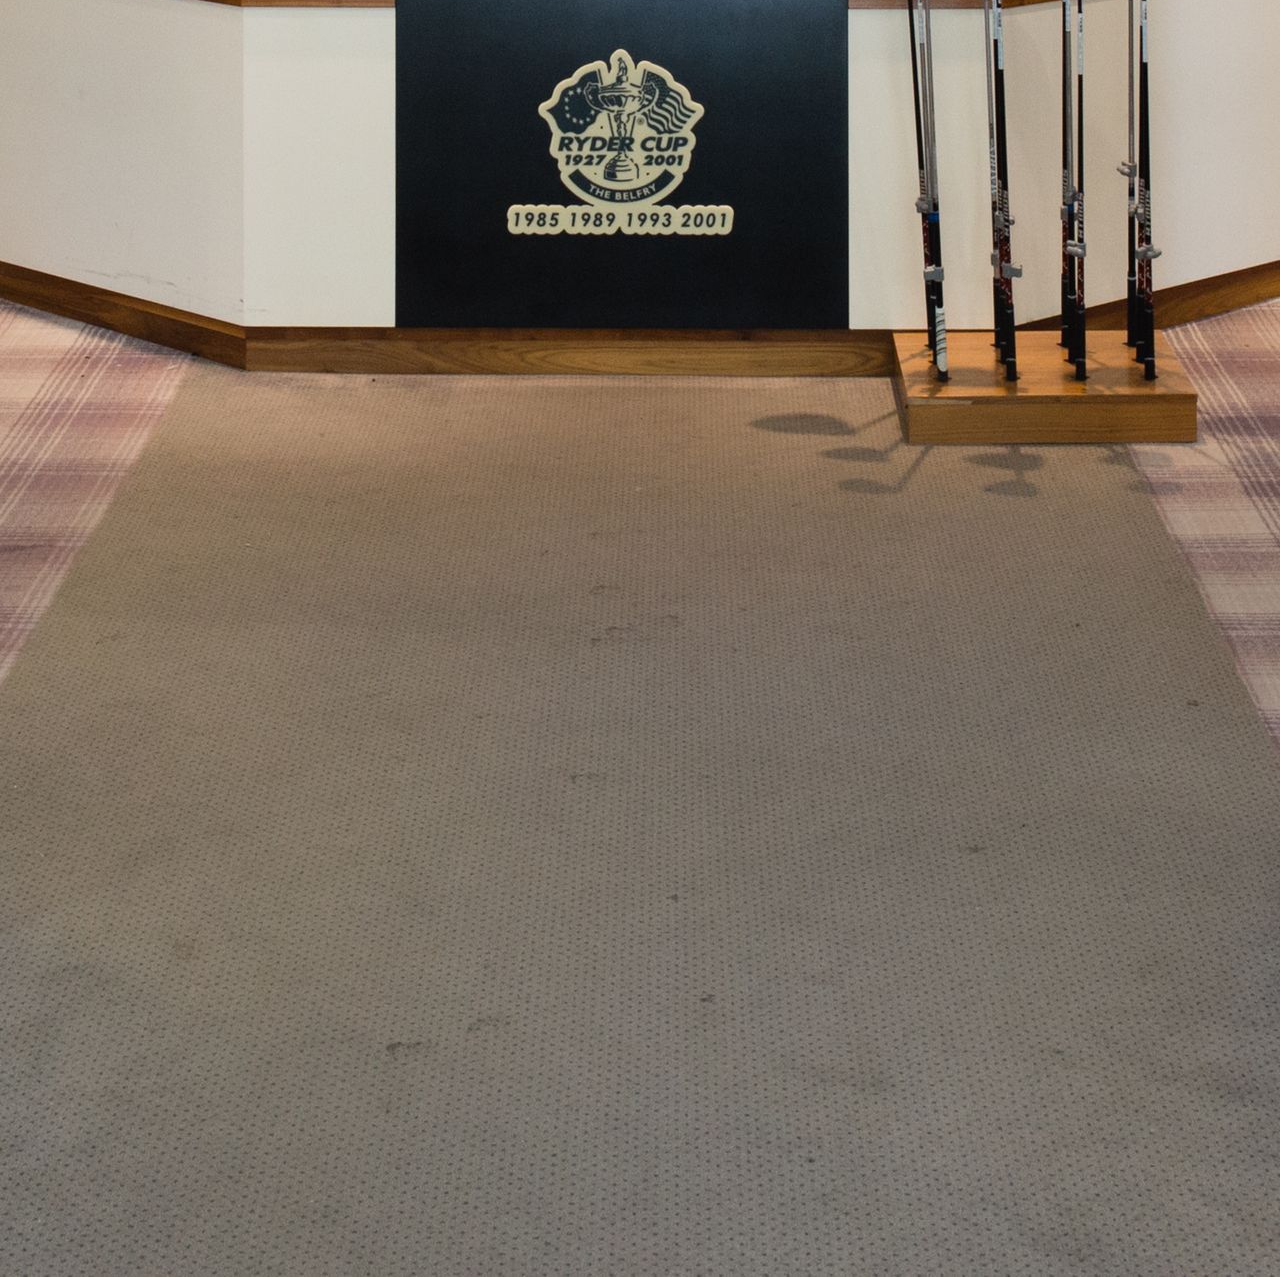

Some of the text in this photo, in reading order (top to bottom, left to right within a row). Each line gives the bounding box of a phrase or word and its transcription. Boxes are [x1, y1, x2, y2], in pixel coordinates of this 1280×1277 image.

[558, 136, 689, 152] RYDER CUP
[564, 154, 684, 166] 1927 2001
[589, 183, 657, 200] THE BELFRY
[514, 212, 728, 227] 1985 1989 1993 2001
